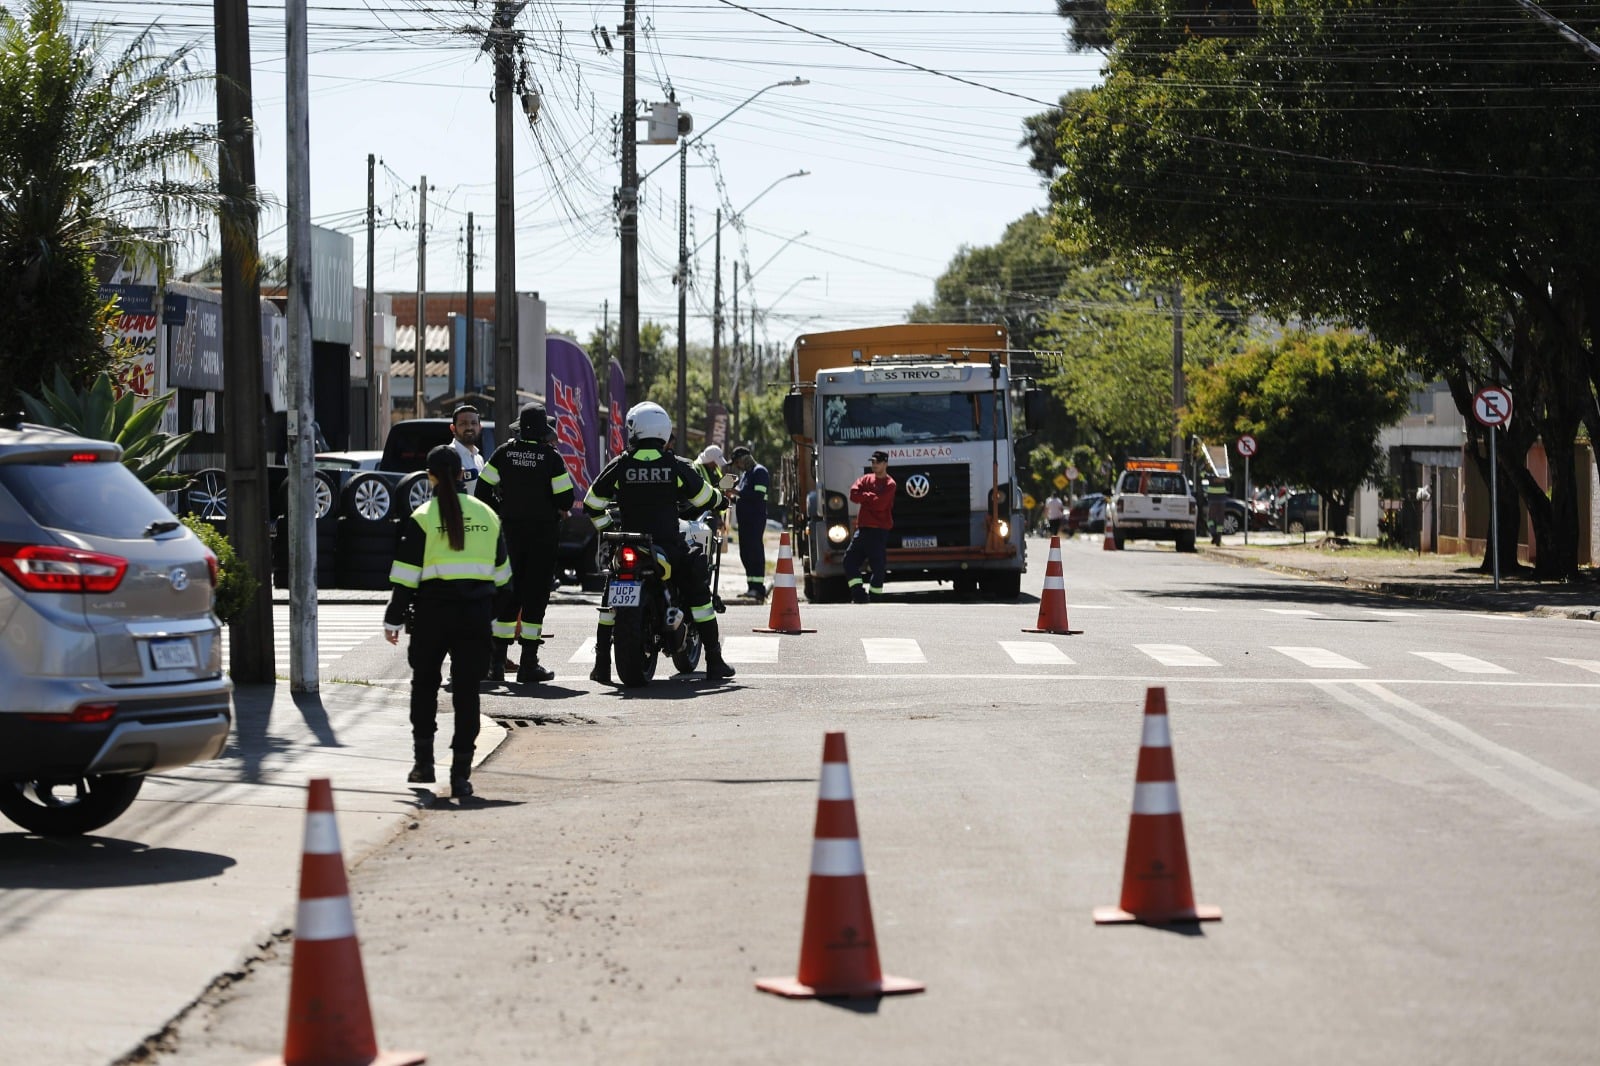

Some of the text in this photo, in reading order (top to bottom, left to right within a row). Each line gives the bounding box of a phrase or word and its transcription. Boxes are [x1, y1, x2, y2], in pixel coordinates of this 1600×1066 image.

[885, 371, 898, 379] SS
[902, 370, 940, 379] TREVO
[506, 451, 536, 460] OPERAÇÕES
[887, 445, 952, 458] INALIZAÇÃO
[625, 467, 671, 481] GRRT
[616, 586, 634, 596] UCP
[612, 595, 636, 605] 6J97
